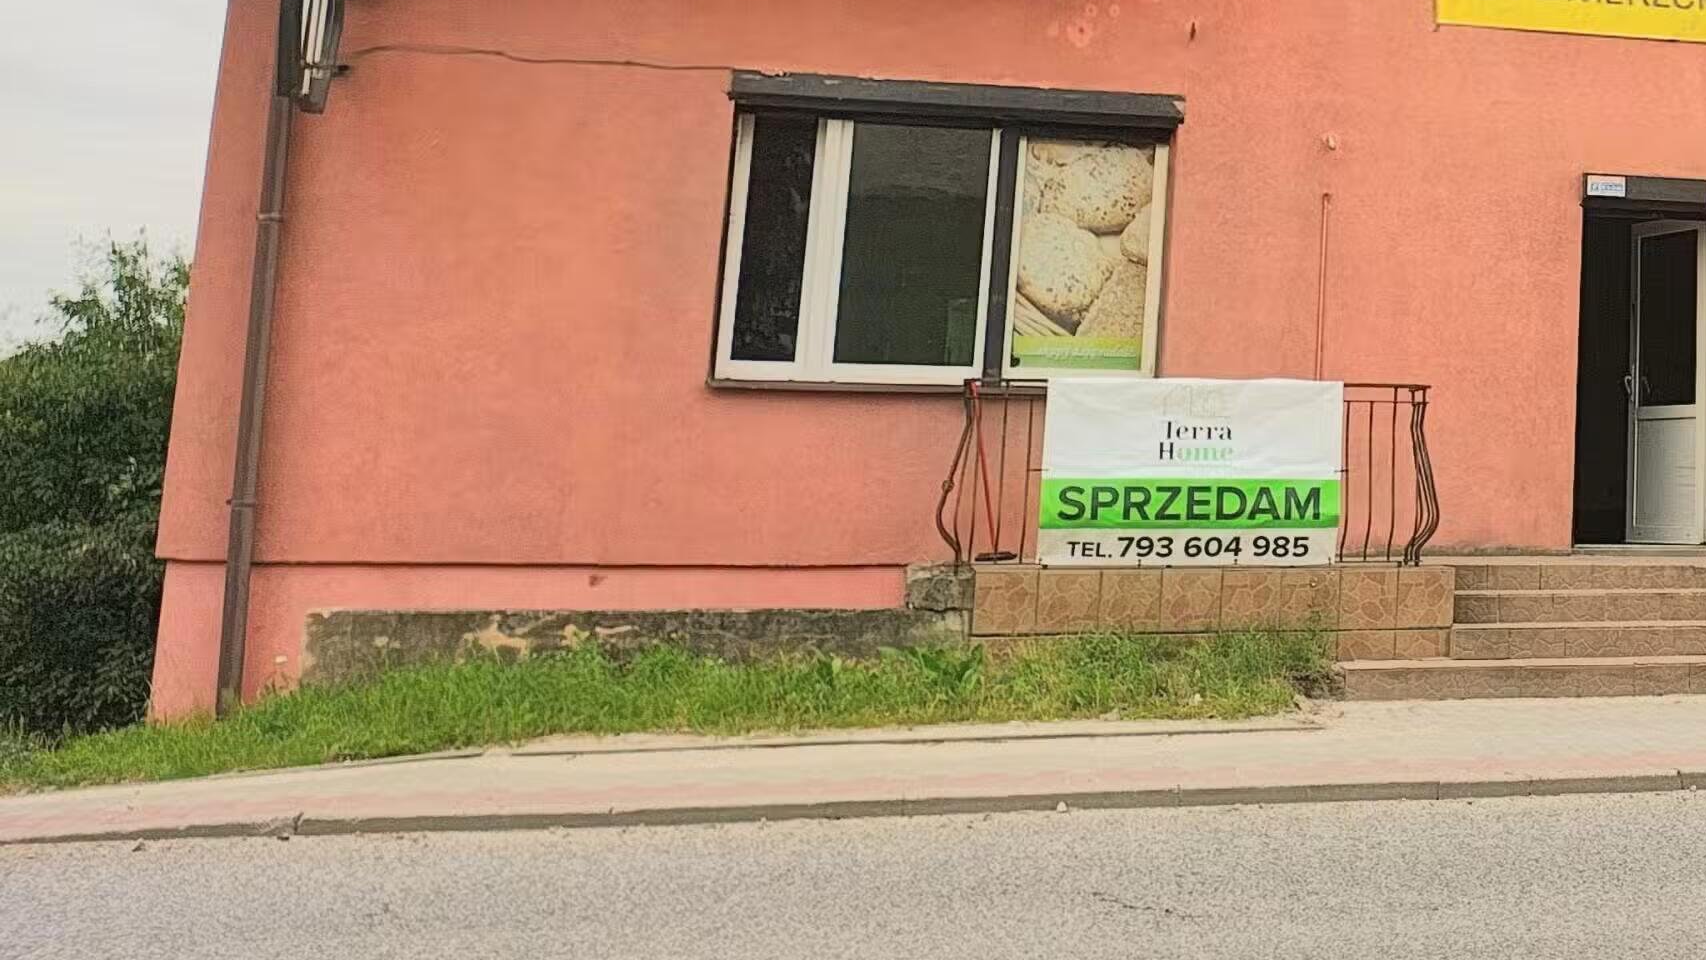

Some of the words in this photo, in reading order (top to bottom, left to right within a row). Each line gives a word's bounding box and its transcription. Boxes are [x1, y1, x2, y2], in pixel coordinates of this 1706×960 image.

[1161, 420, 1232, 440] Terra
[1057, 486, 1321, 521] SPRZEDAM
[1067, 541, 1112, 558] TEL.
[1117, 536, 1174, 557] 793
[1183, 536, 1242, 557] 604
[1252, 536, 1310, 557] 985
